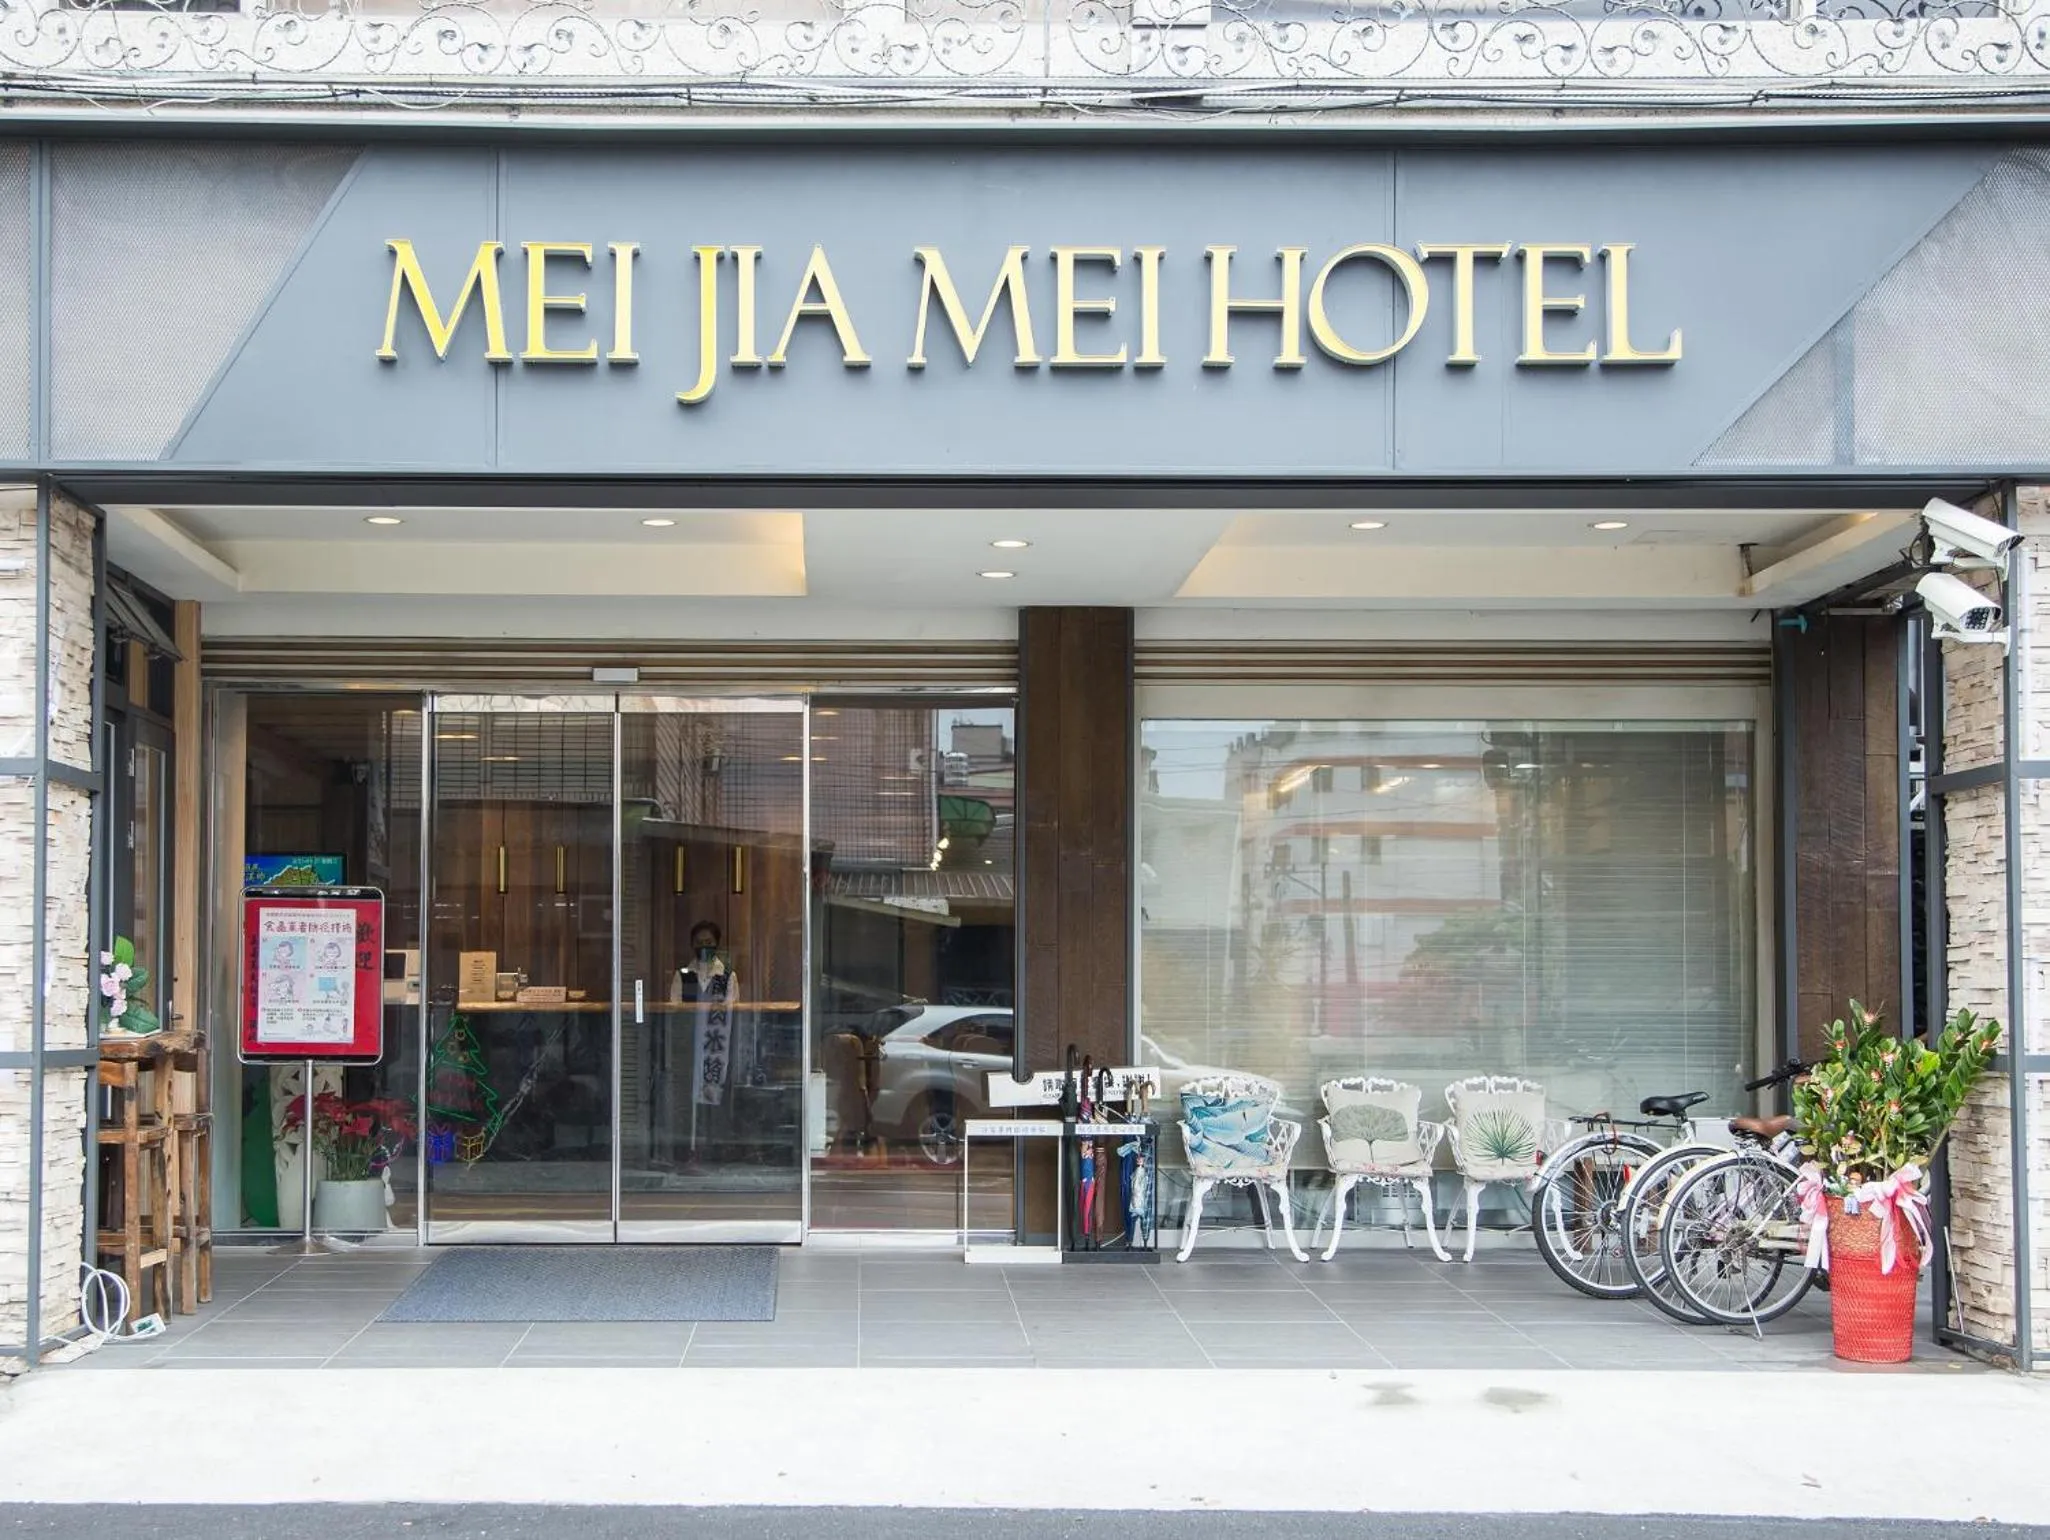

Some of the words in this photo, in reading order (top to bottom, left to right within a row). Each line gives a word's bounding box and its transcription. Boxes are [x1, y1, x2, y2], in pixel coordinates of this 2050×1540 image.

[375, 238, 641, 365] MEI
[675, 243, 872, 404] JIA
[906, 245, 1166, 368] MEI
[1202, 242, 1683, 368] HOTEL
